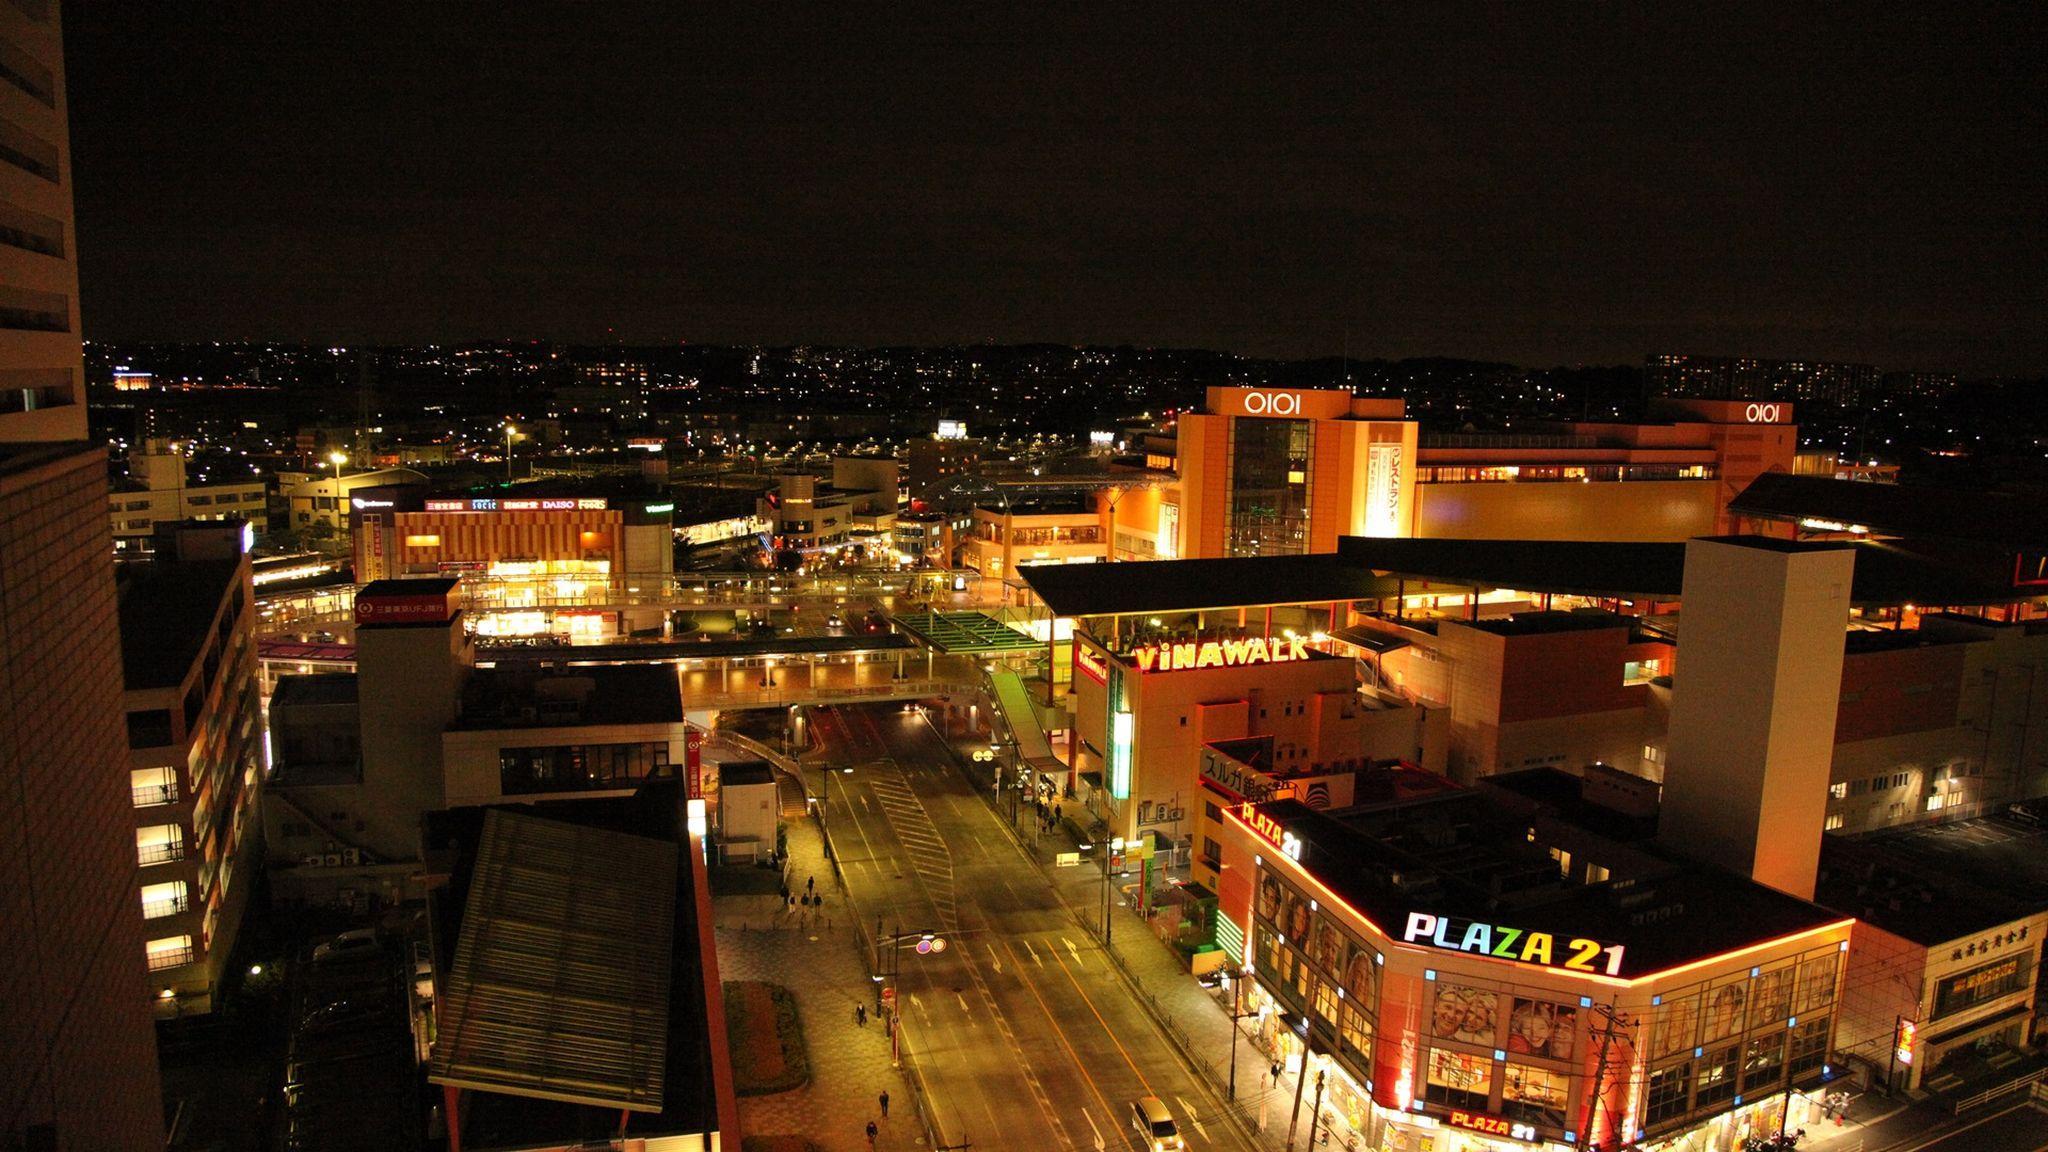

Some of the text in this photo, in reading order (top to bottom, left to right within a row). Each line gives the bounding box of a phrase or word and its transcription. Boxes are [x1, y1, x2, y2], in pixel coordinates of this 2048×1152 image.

[542, 500, 575, 510] DAISO
[1242, 801, 1302, 861] PLAZA 21
[1403, 911, 1625, 976] PLAZA 21
[1450, 1111, 1536, 1141] PLAZA 21
